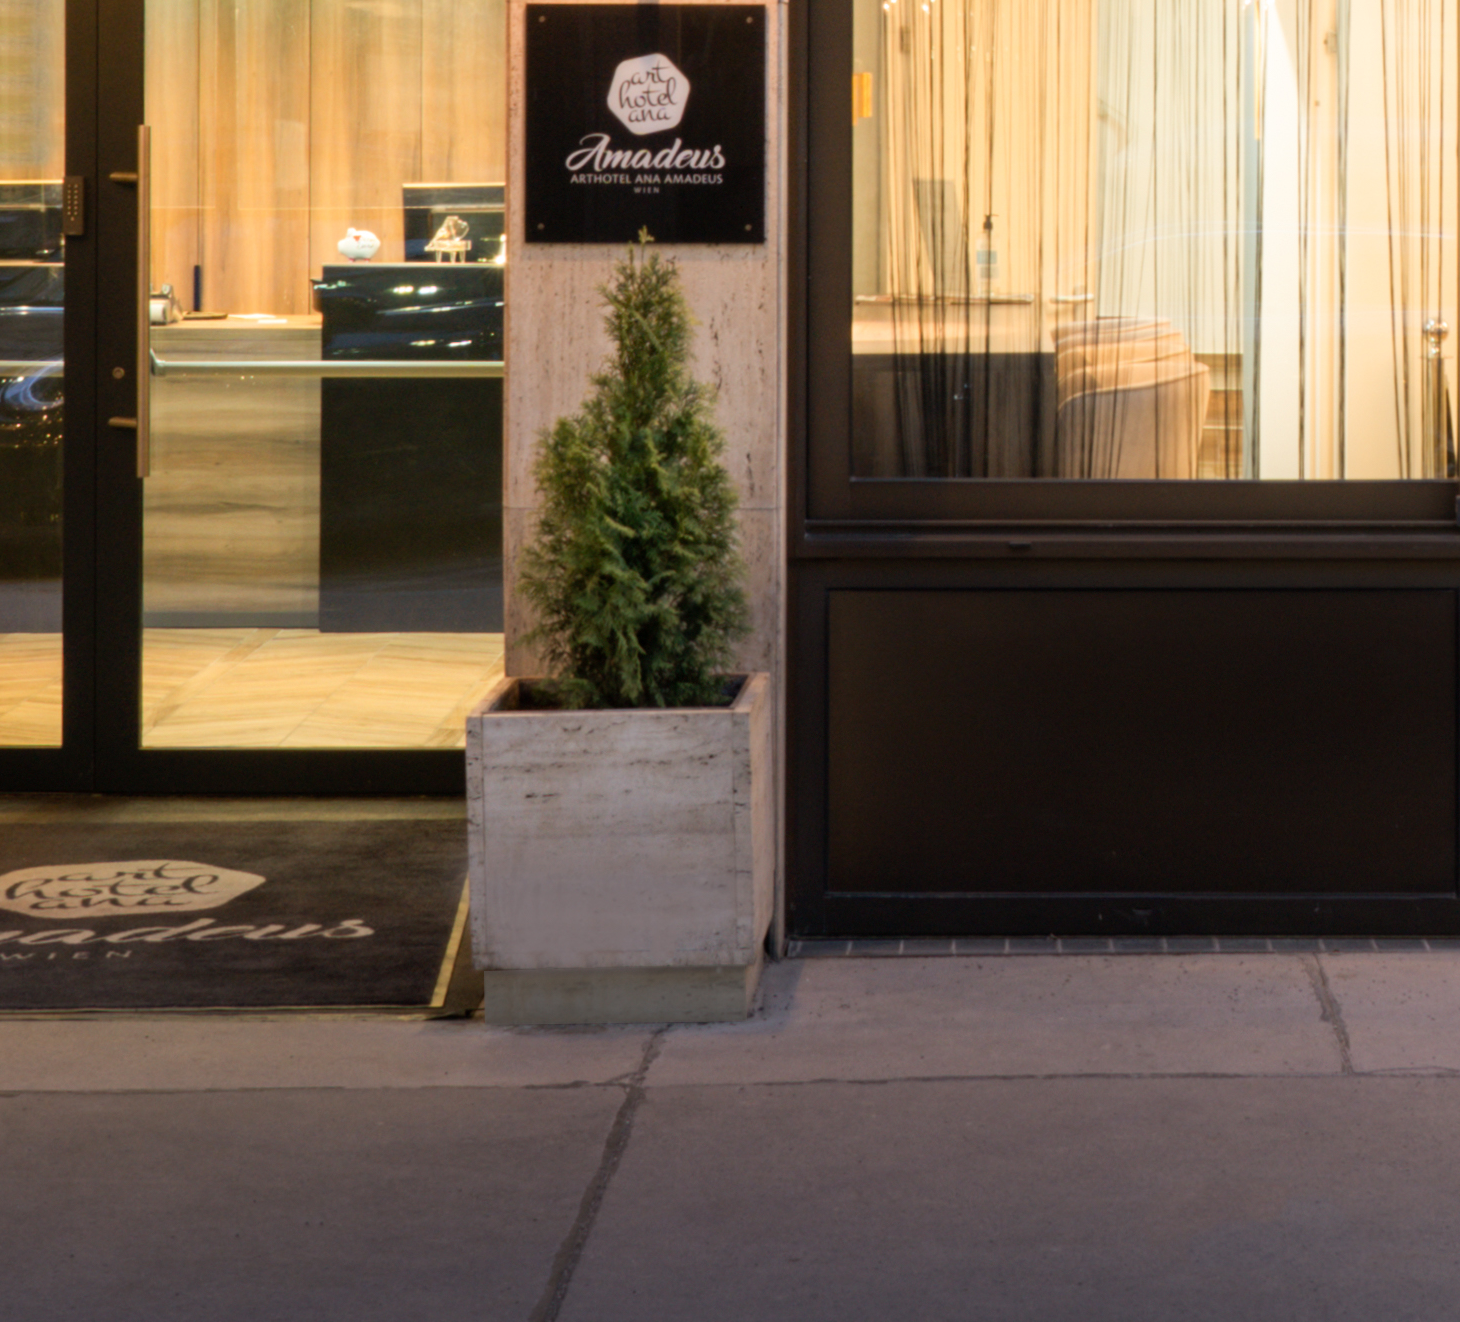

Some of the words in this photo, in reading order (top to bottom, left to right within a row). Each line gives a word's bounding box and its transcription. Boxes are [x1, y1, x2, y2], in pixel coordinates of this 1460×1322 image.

[630, 60, 671, 86] art
[619, 76, 677, 109] hotel
[628, 108, 672, 123] ana
[565, 132, 726, 172] Amadeus
[570, 173, 632, 184] ARTHOTEL
[635, 173, 661, 184] ANA
[664, 173, 723, 184] AMADEUS
[633, 186, 660, 194] WIEN
[57, 863, 208, 882] art
[5, 874, 220, 900] hotel
[29, 895, 192, 910] ana
